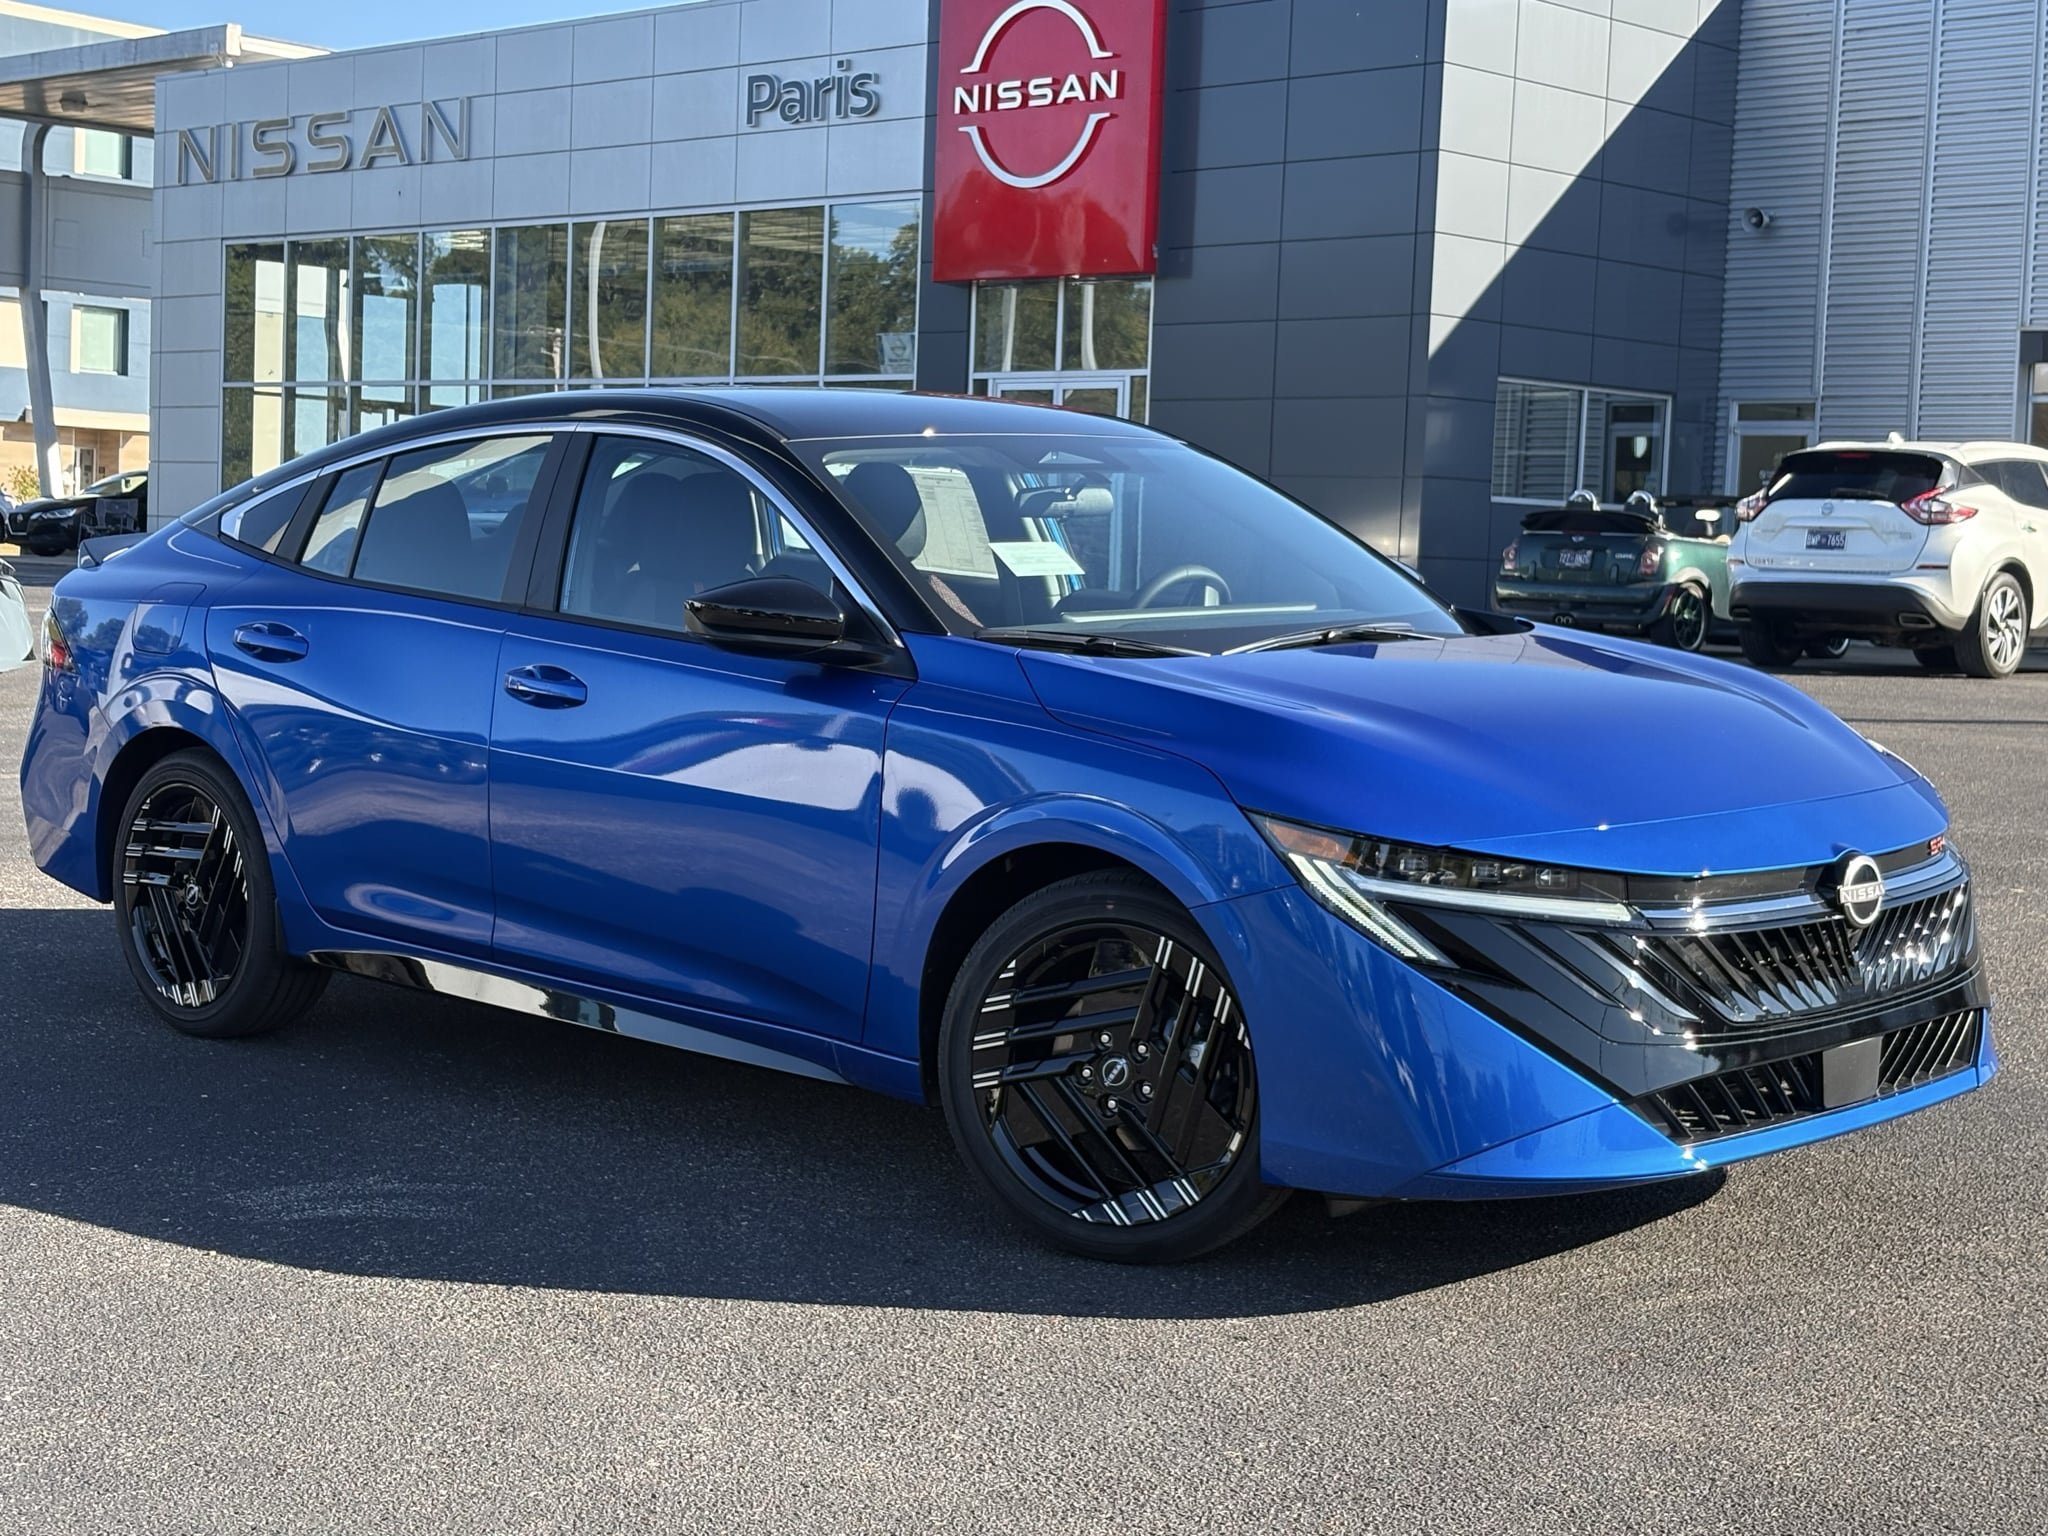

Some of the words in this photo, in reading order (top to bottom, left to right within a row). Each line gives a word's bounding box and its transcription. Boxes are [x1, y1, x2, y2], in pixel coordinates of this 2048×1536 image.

[746, 59, 879, 127] Paris
[953, 69, 1119, 114] NISSAN
[177, 97, 470, 185] NISSAN
